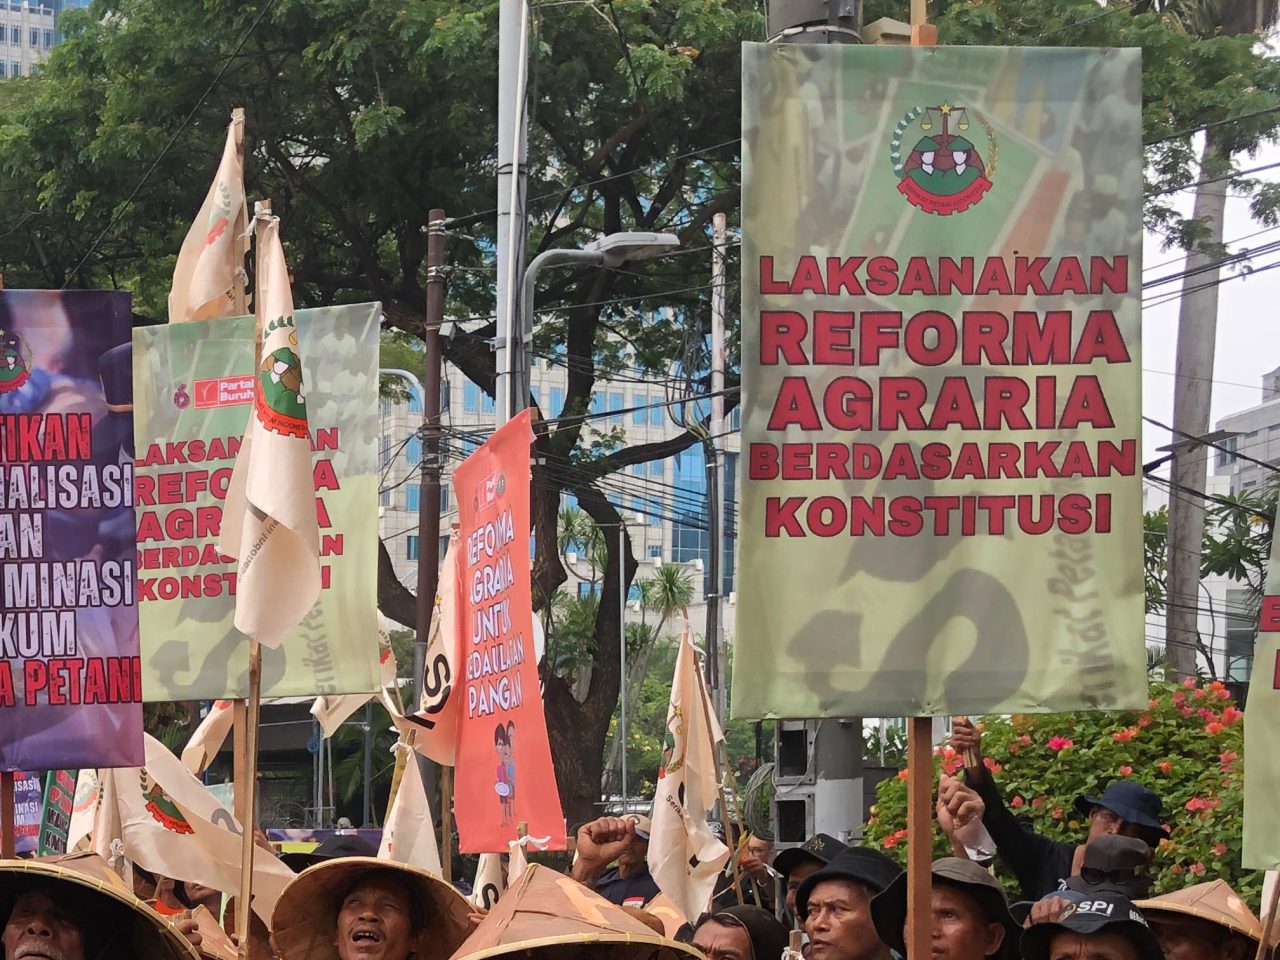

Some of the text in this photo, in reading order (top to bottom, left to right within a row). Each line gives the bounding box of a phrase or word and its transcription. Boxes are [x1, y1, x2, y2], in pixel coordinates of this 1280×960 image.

[760, 255, 1128, 296] LAKSANAKAN
[760, 310, 1131, 366] REFORMA
[220, 379, 255, 391] Partai
[220, 390, 255, 401] Buruh
[767, 375, 1115, 431] AGRARIA
[749, 439, 1136, 480] BERDASARKAN
[135, 459, 340, 506] REFOA
[765, 494, 1112, 537] KONSTITUSI
[24, 656, 142, 706] PETANI
[469, 672, 523, 718] PANGAN
[1077, 900, 1114, 915] SPI
